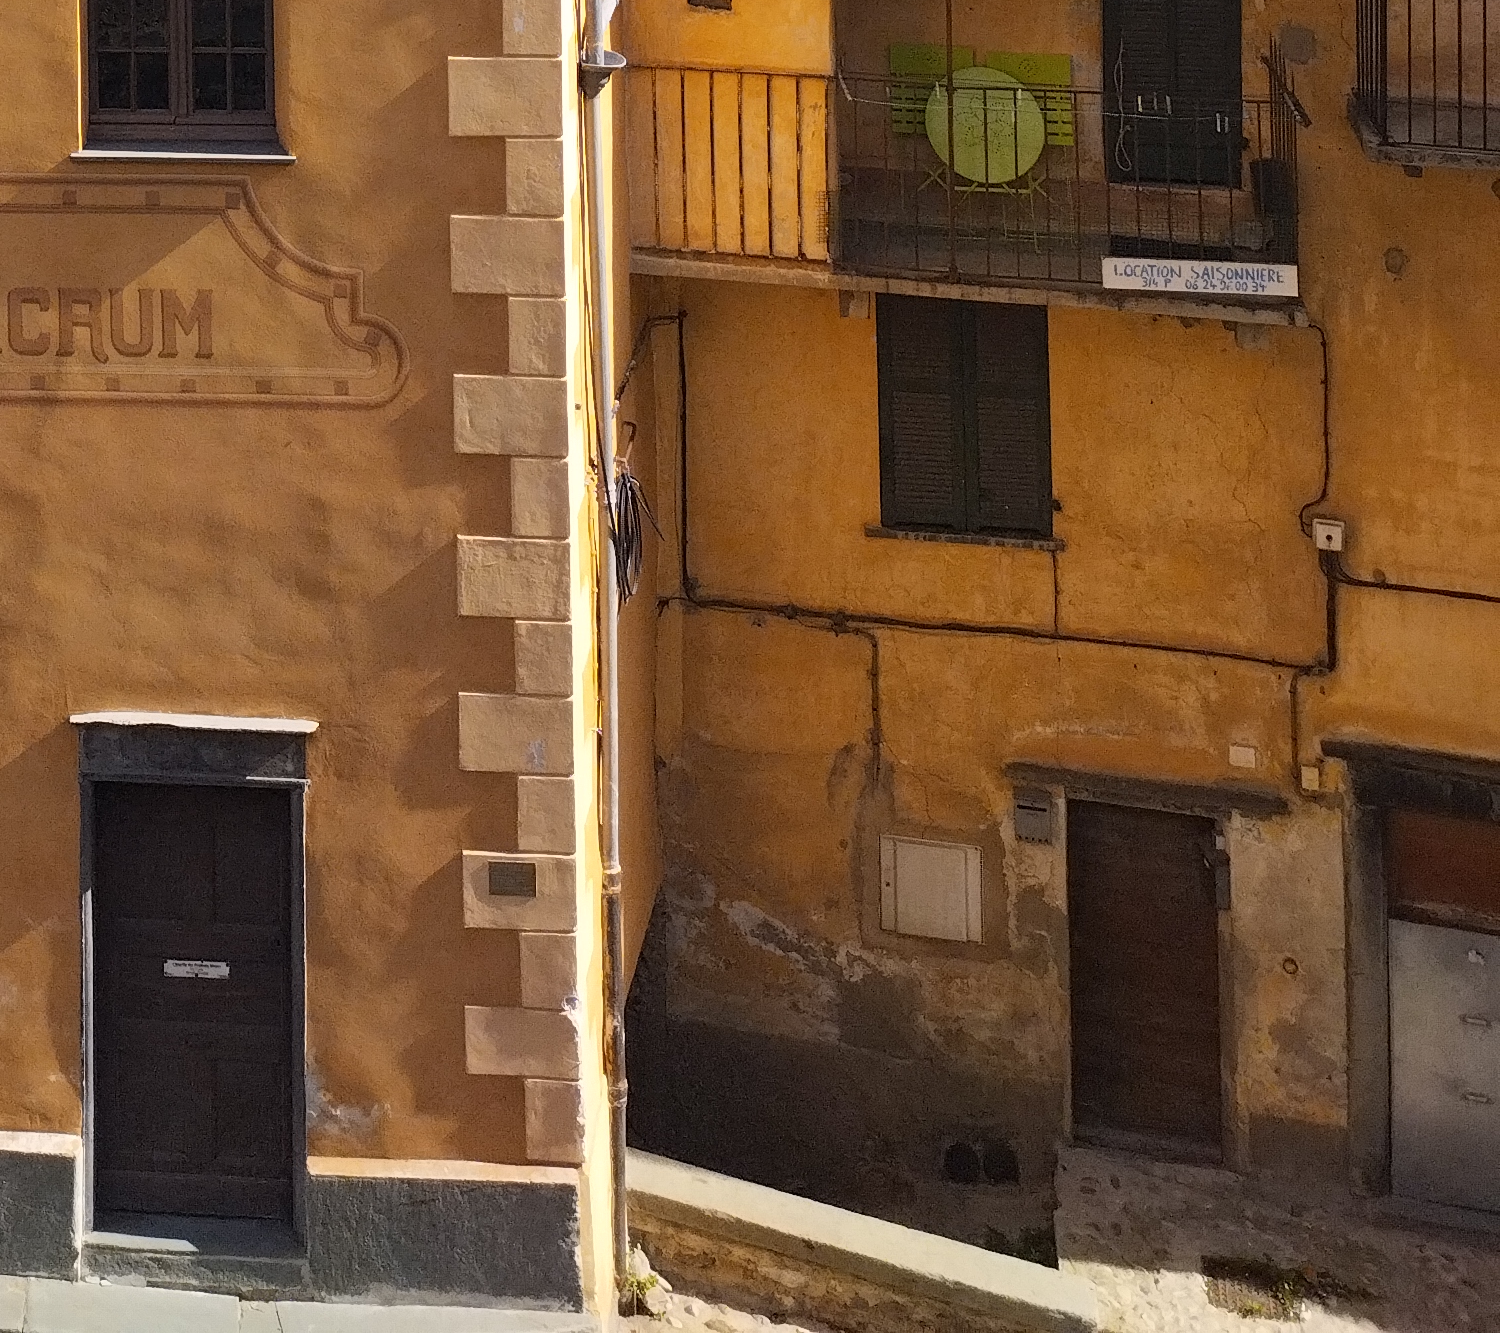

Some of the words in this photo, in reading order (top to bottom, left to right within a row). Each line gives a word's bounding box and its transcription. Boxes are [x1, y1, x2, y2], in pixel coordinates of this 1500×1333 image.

[1113, 263, 1182, 279] LOCATION
[1190, 265, 1285, 284] SAISONNIERE
[1185, 278, 1199, 291] 06
[1202, 278, 1217, 291] 24
